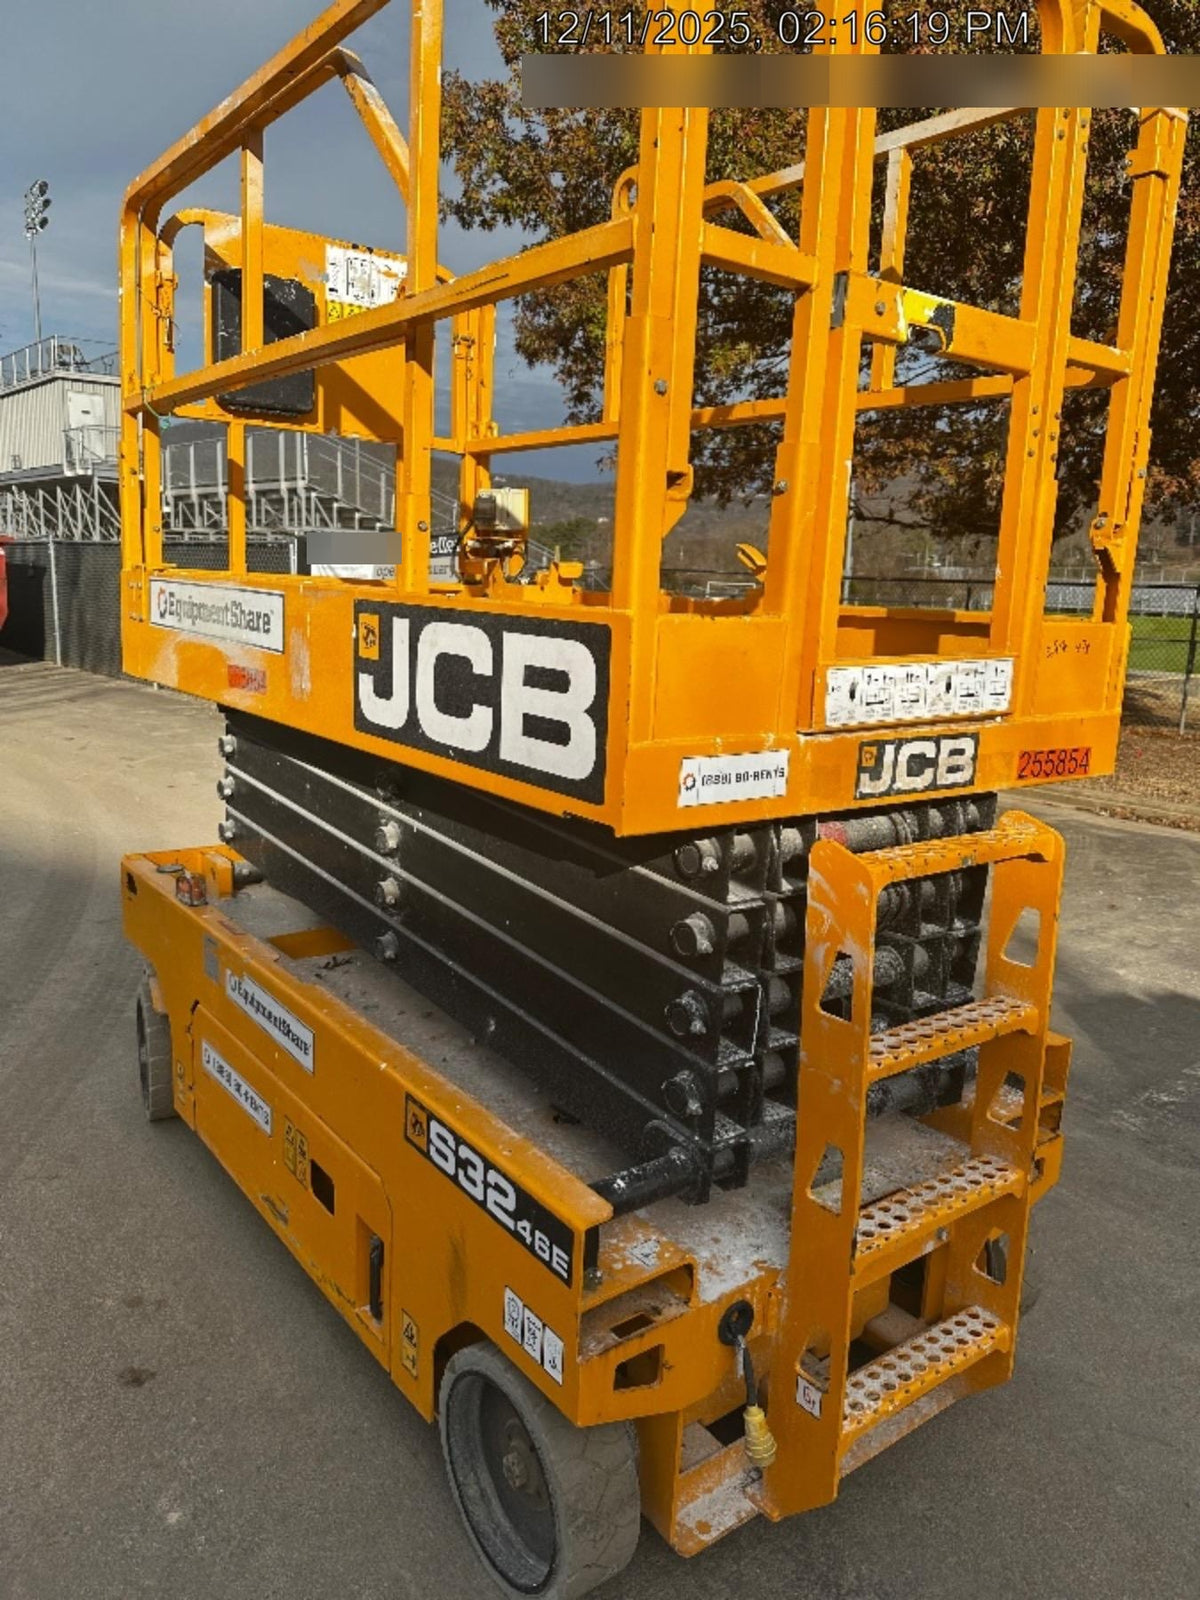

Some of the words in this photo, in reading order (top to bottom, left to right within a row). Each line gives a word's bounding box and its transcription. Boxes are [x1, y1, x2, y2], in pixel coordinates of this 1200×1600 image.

[168, 591, 271, 635] EquipmentShare
[359, 616, 596, 781] JCB
[858, 737, 975, 795] JCB
[1018, 748, 1090, 780] 255854
